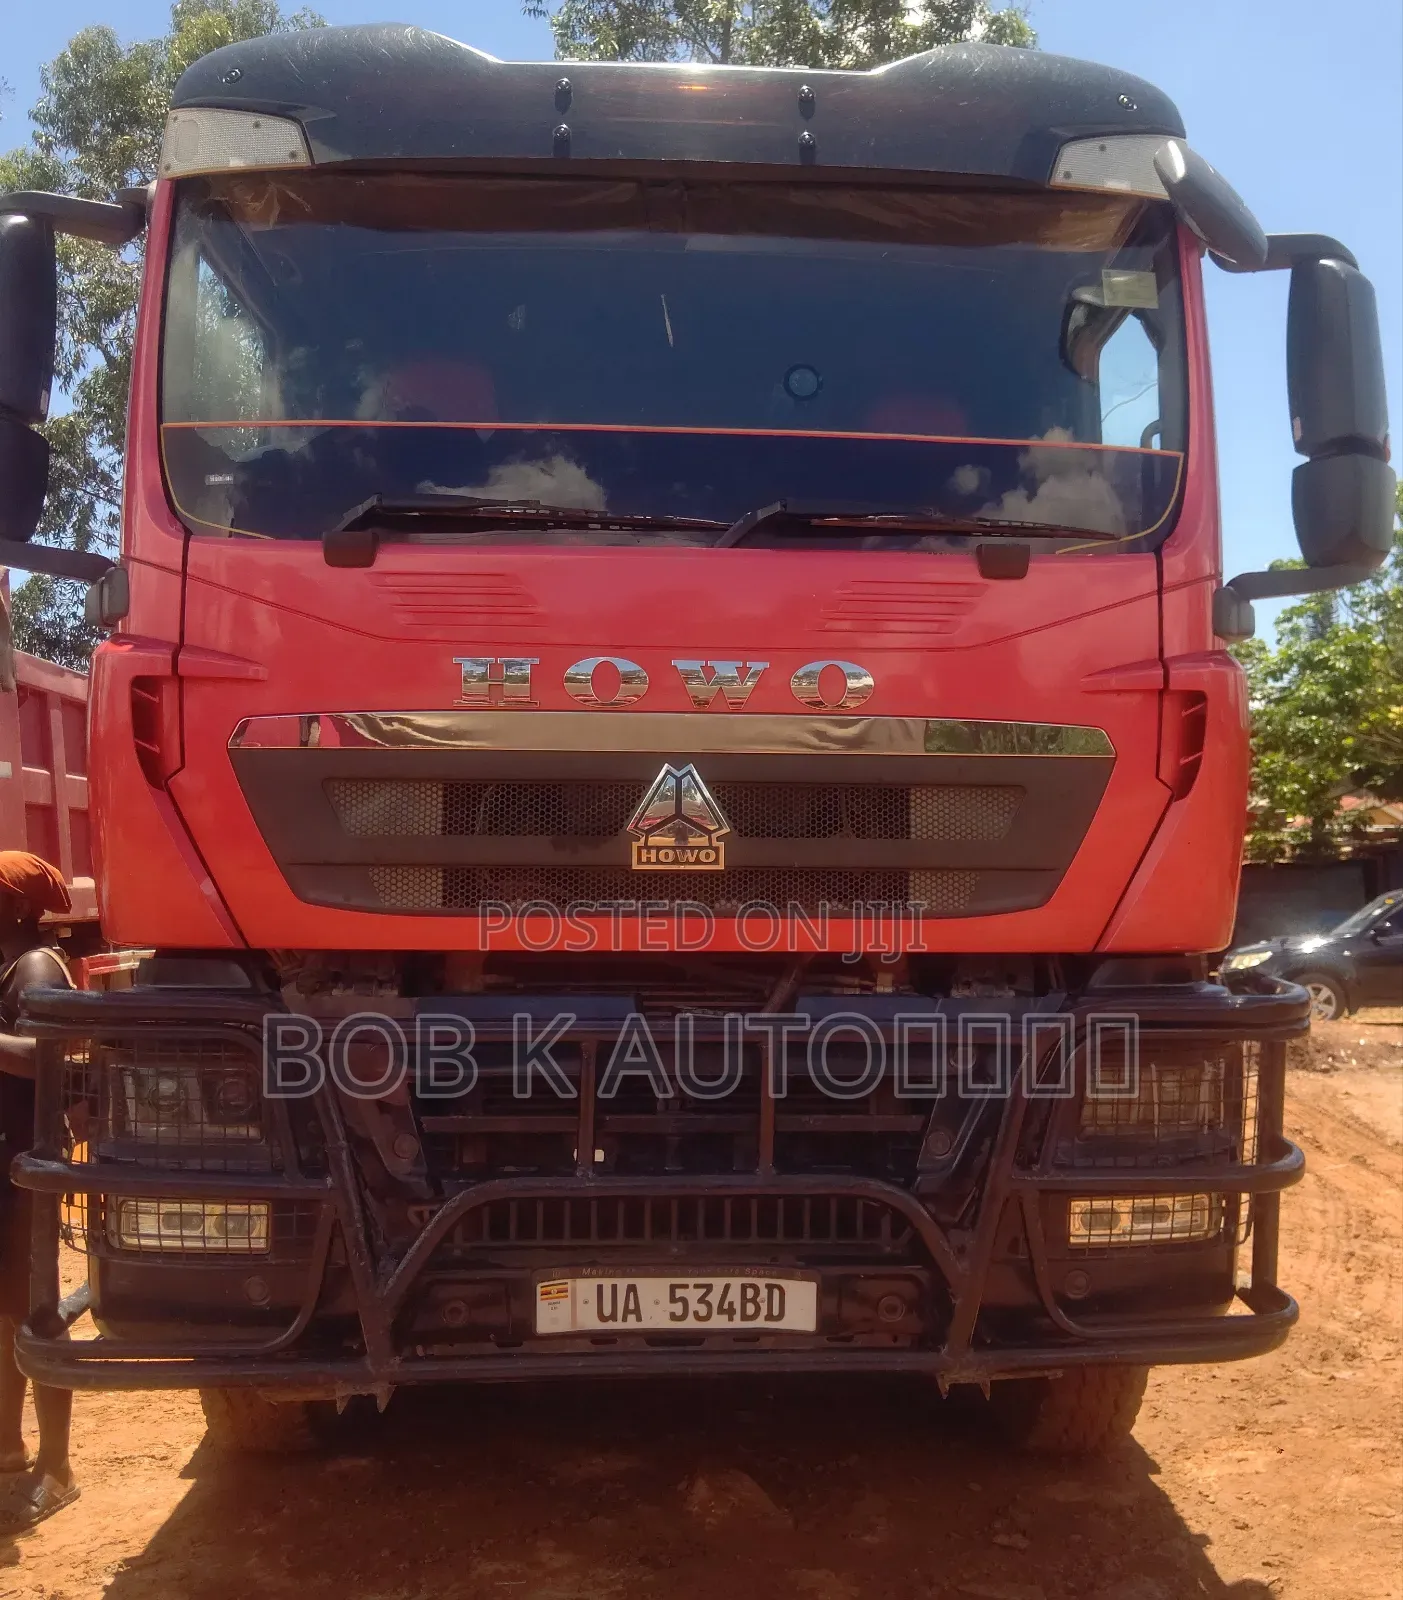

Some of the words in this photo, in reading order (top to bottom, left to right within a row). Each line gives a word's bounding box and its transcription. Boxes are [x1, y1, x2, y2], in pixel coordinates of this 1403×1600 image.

[452, 656, 875, 711] HOWO
[640, 848, 717, 864] HOWO
[596, 1283, 643, 1323] UA
[668, 1283, 786, 1323] 534BD
